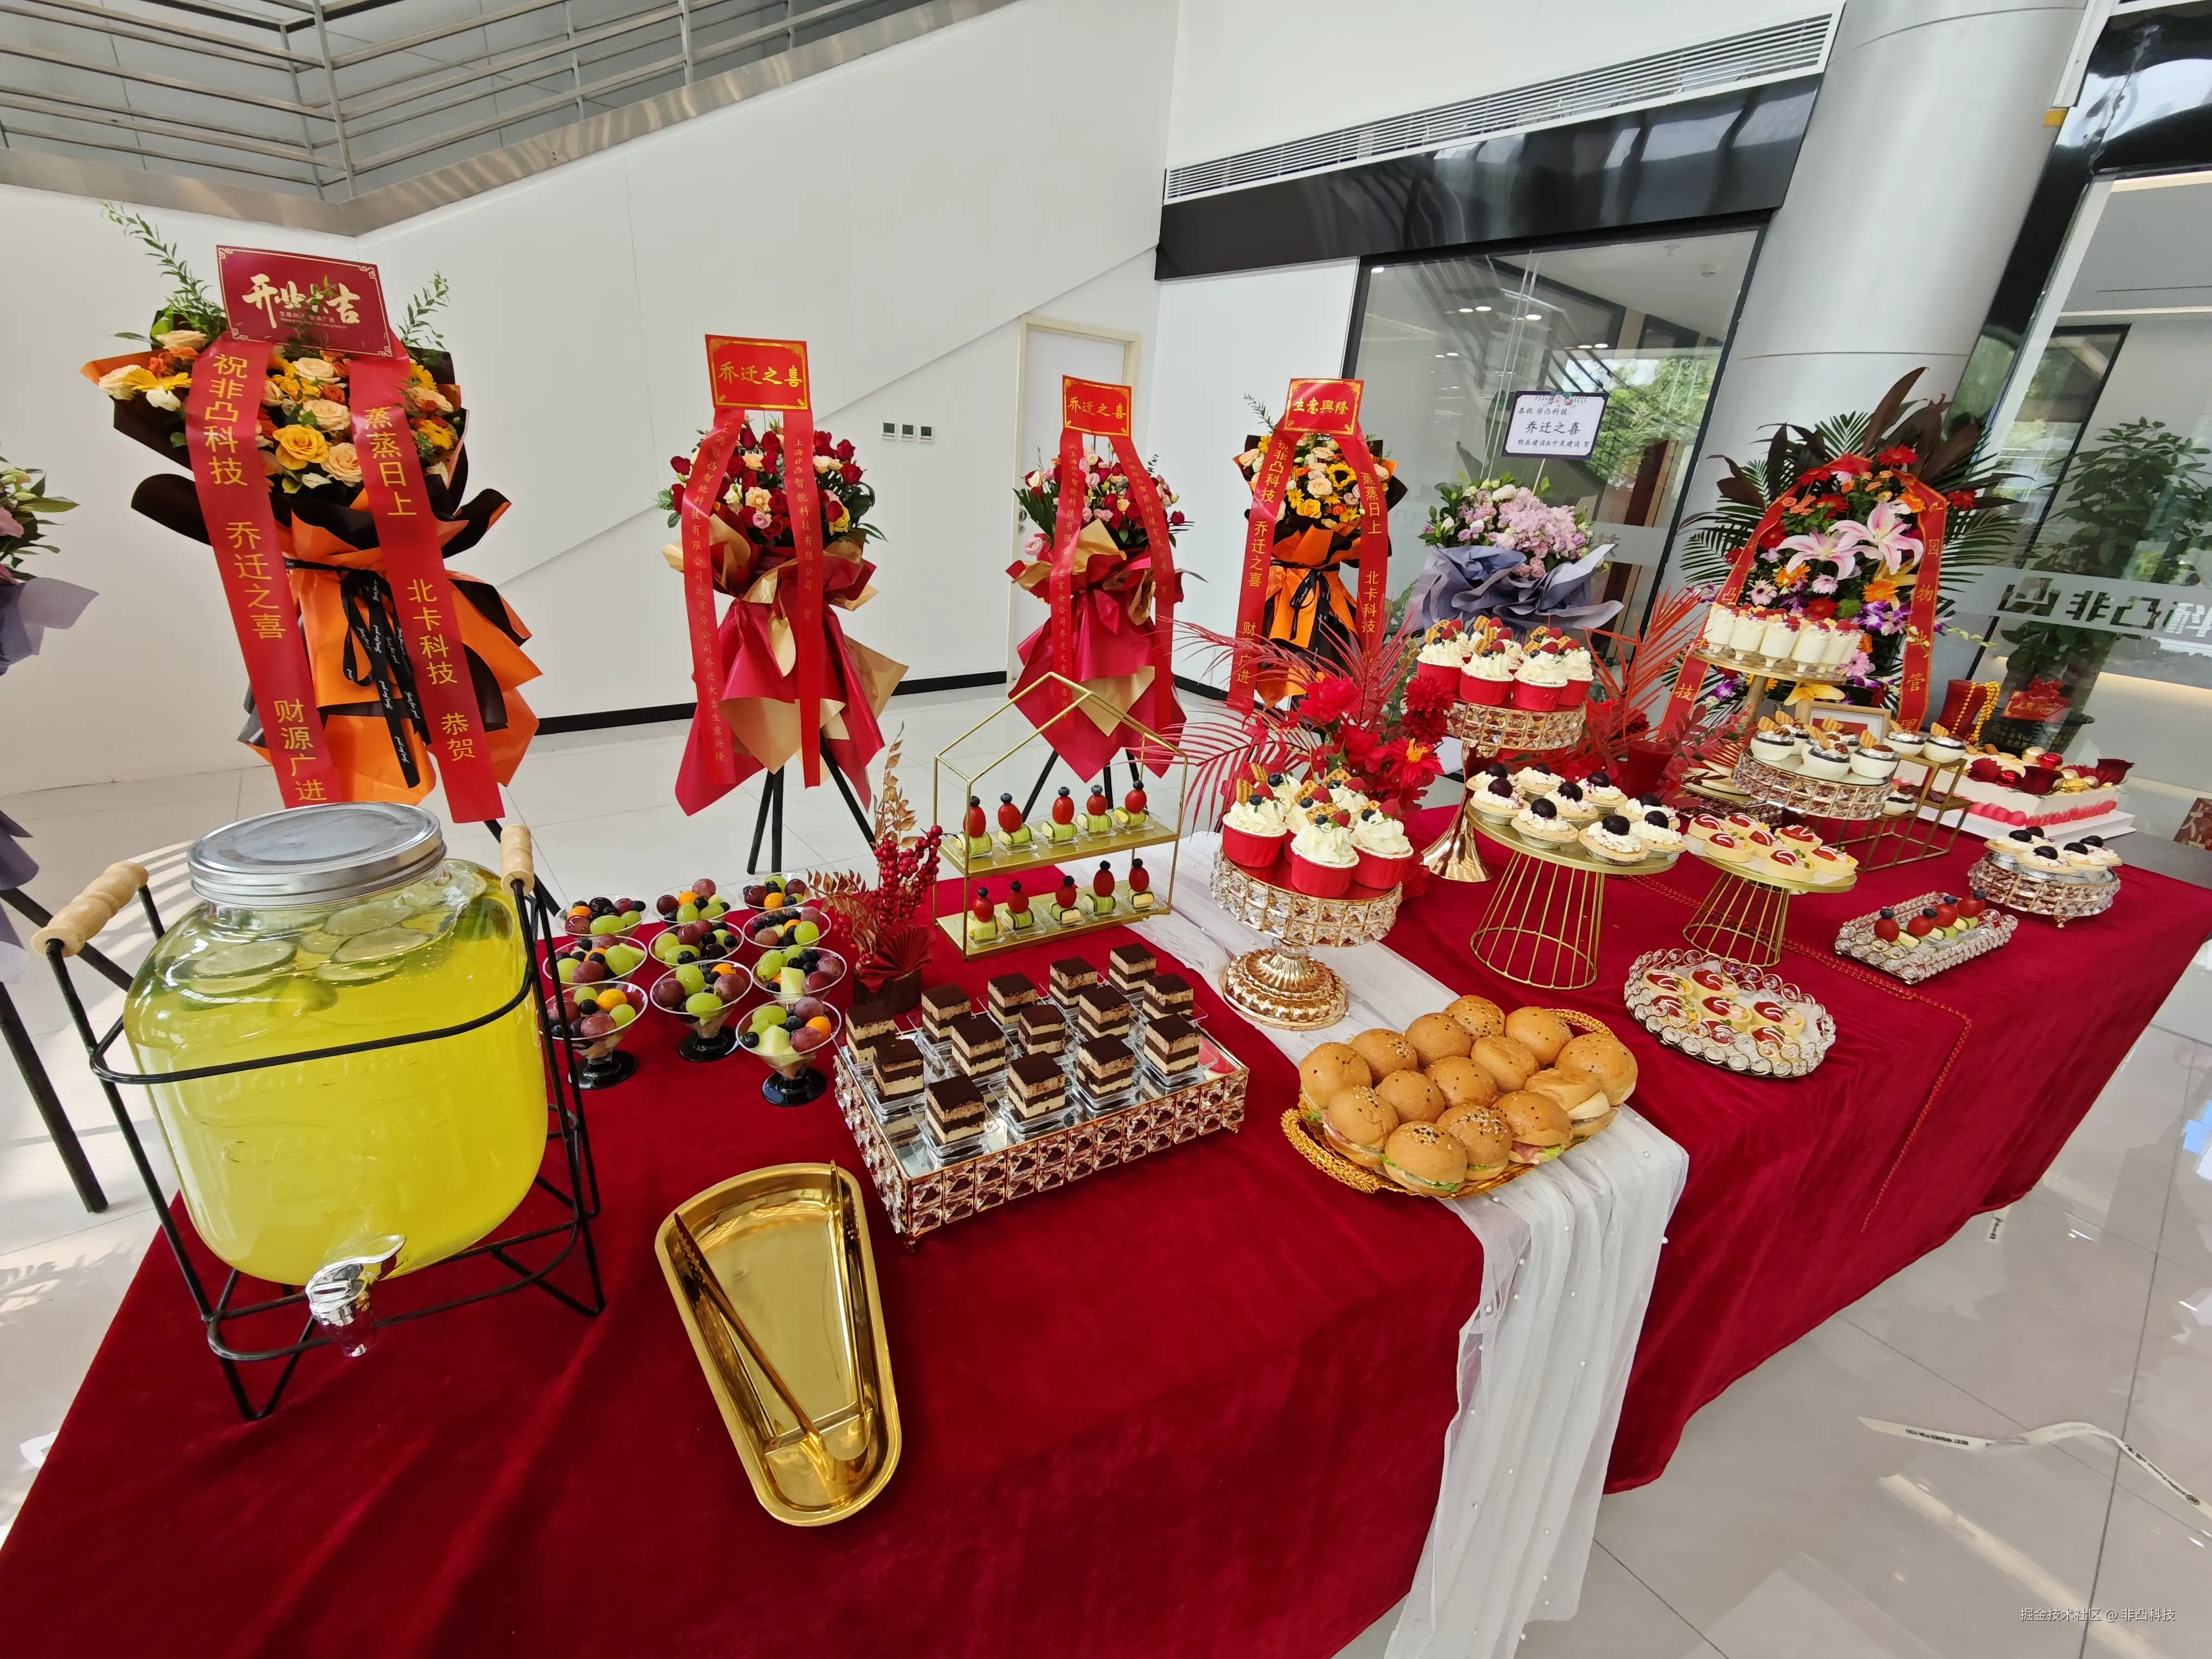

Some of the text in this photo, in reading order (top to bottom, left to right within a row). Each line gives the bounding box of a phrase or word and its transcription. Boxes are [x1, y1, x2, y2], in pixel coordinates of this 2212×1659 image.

[717, 361, 803, 388] 乔迁之喜
[1068, 396, 1127, 420] 乔迁之喜
[1525, 421, 1581, 435] 乔迁之喜
[793, 439, 814, 591] 上海非凸智能科技有限公司
[1360, 472, 1382, 535] 蒸蒸日上
[203, 353, 328, 802] 祝非凸科技 乔迁之喜 财源广进
[363, 406, 477, 762] 蒸蒸日上 北卡科技 恭贺
[1057, 443, 1079, 719] 祝上海非凸智能科技有限公司北京分公司乔迁大吉意兴
[1237, 440, 1289, 684] 祝非凸科技 乔迁之喜 财广进
[1361, 571, 1379, 634] 北卡科技
